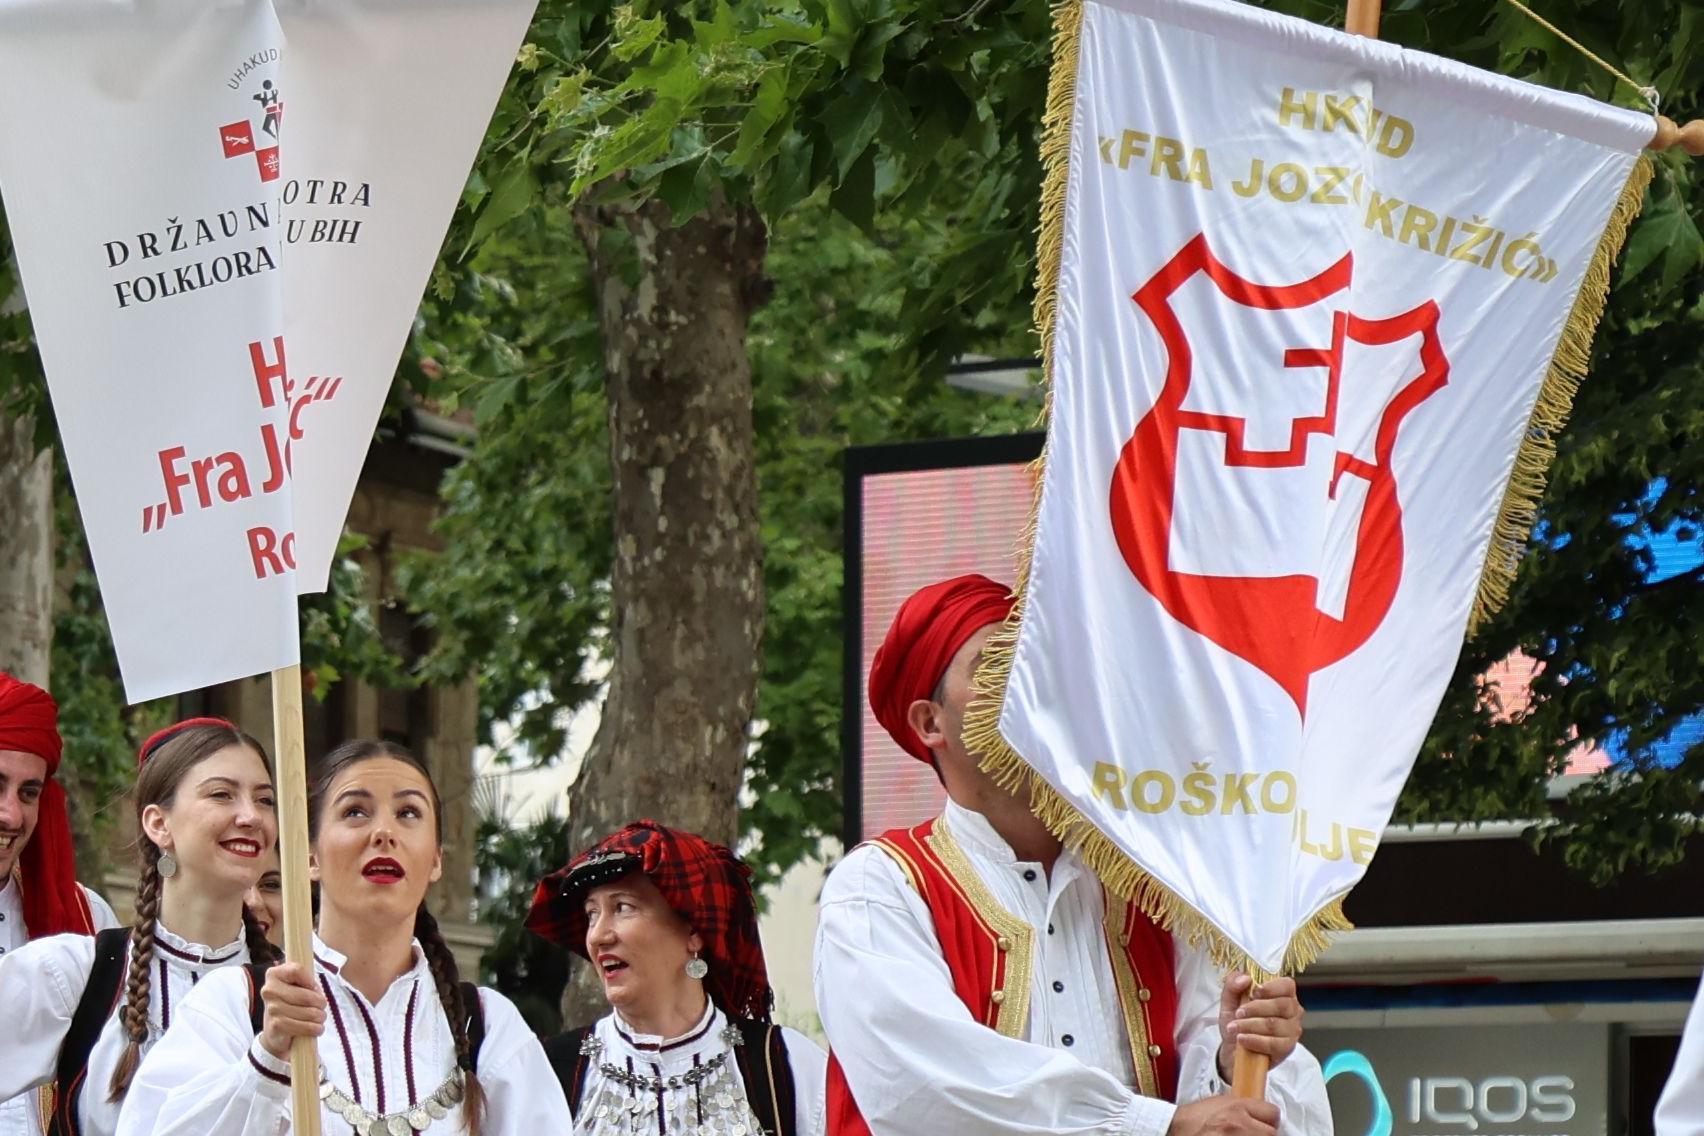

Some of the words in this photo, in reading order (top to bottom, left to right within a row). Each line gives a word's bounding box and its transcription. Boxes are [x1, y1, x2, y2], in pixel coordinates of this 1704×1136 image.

[282, 180, 371, 207] OTRA
[114, 246, 277, 308] FOLKLORA
[286, 219, 305, 244] U
[309, 218, 362, 244] BIH
[1364, 191, 1559, 283] KRIŽIĆ»
[248, 336, 289, 409] H
[1292, 809, 1376, 865] LJE
[1407, 1076, 1576, 1130] IQOS
